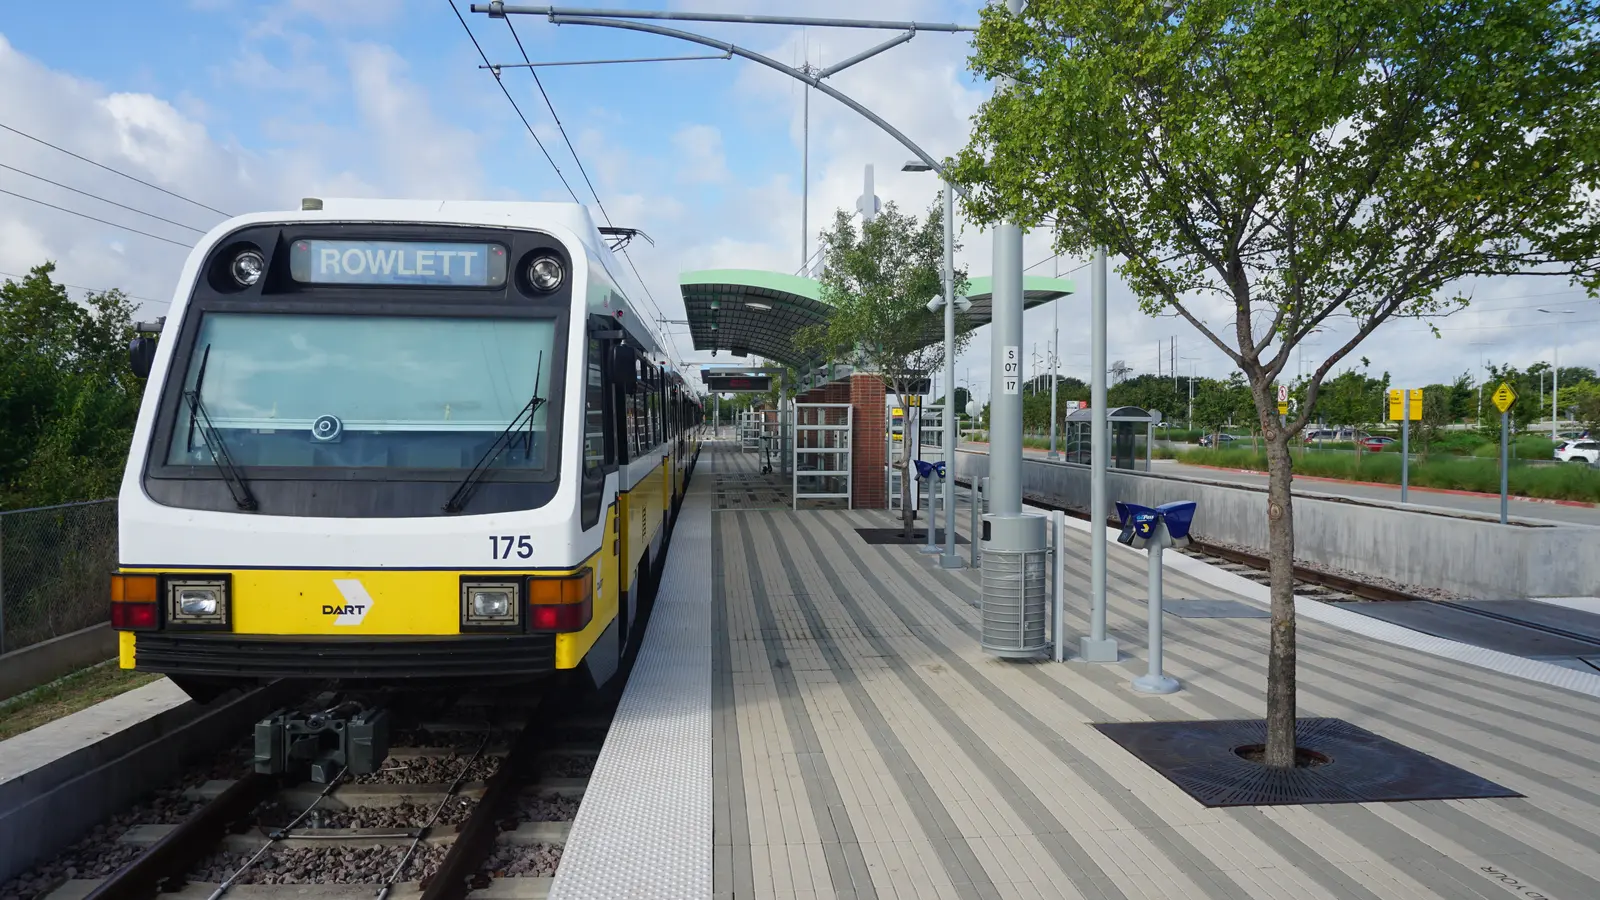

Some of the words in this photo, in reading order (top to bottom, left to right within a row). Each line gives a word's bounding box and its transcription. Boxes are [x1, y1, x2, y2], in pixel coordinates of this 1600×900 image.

[320, 248, 478, 276] ROWLETT
[1008, 350, 1015, 359] S
[1004, 362, 1017, 372] 07
[1006, 381, 1016, 390] 17
[489, 535, 534, 560] 175
[322, 605, 365, 615] DART
[1480, 866, 1527, 890] YOUR
